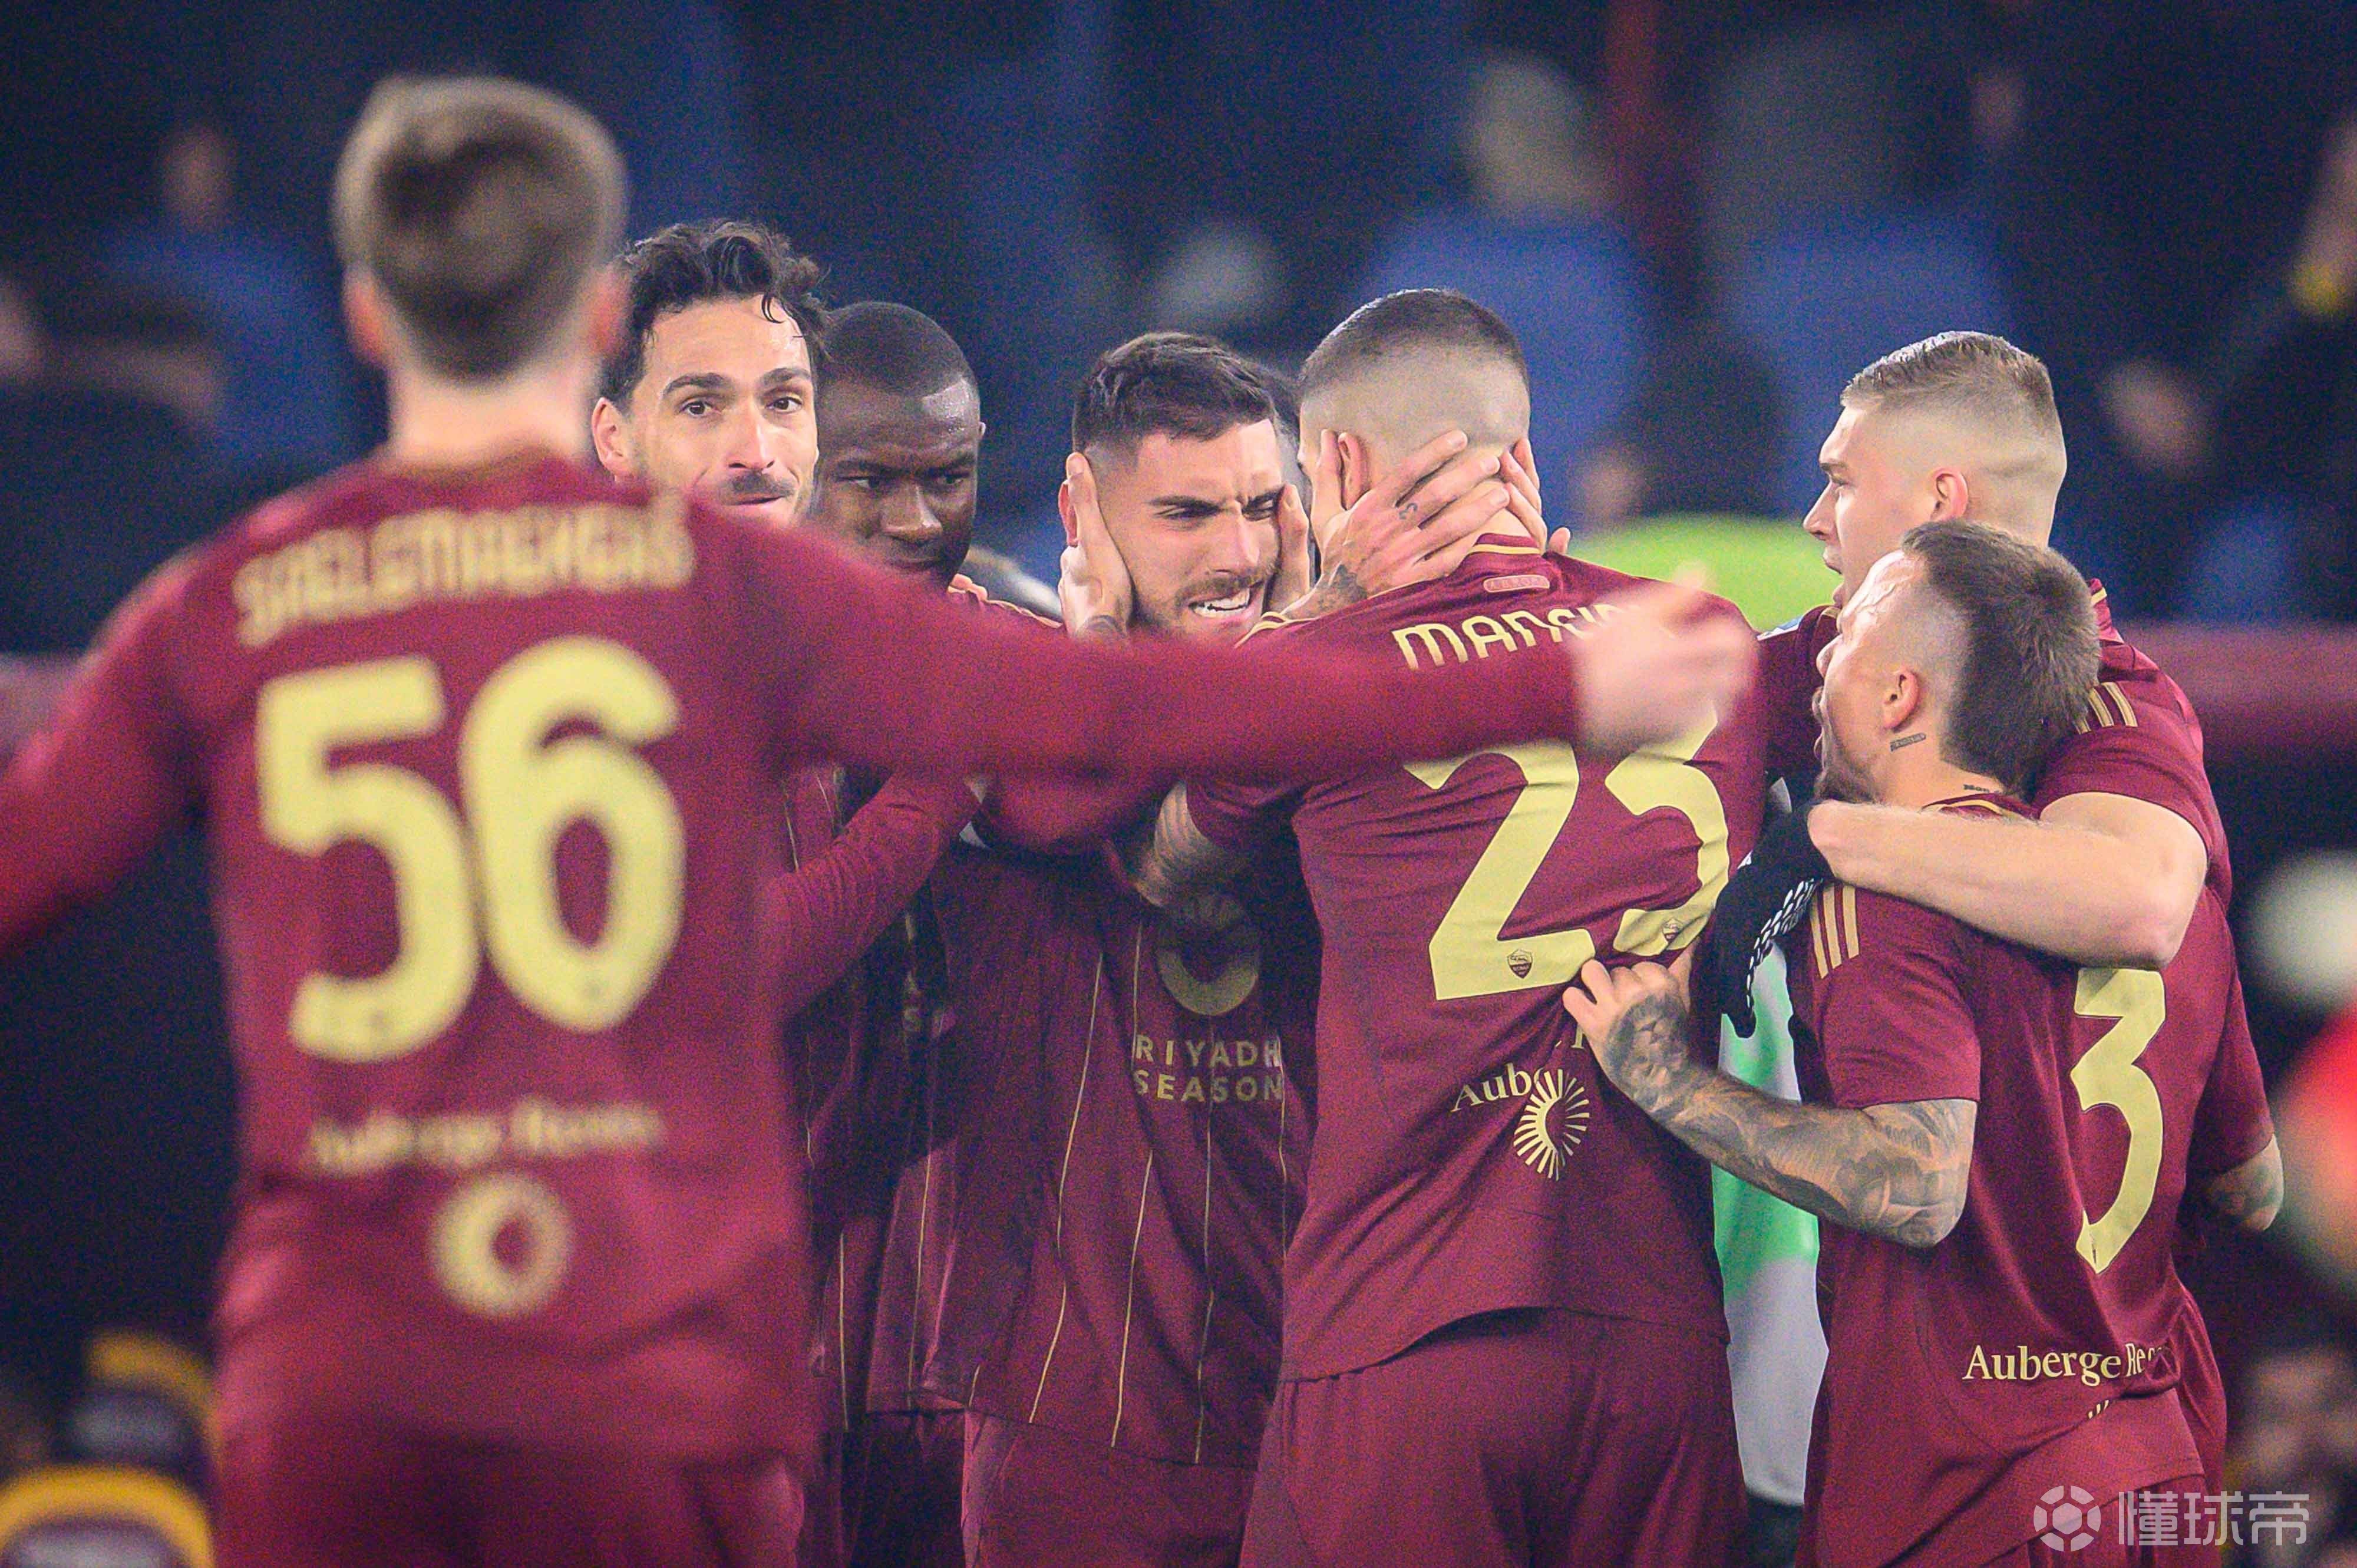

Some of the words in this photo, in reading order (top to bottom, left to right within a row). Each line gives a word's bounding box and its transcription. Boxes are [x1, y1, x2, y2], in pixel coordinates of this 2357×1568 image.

[256, 634, 687, 1062] 56
[1403, 701, 1731, 1001] 23
[1133, 1034, 1283, 1068] RIYADH
[1133, 1069, 1285, 1102] SEASON
[2069, 967, 2166, 1275] 3
[1962, 1345, 2122, 1386] Auberge
